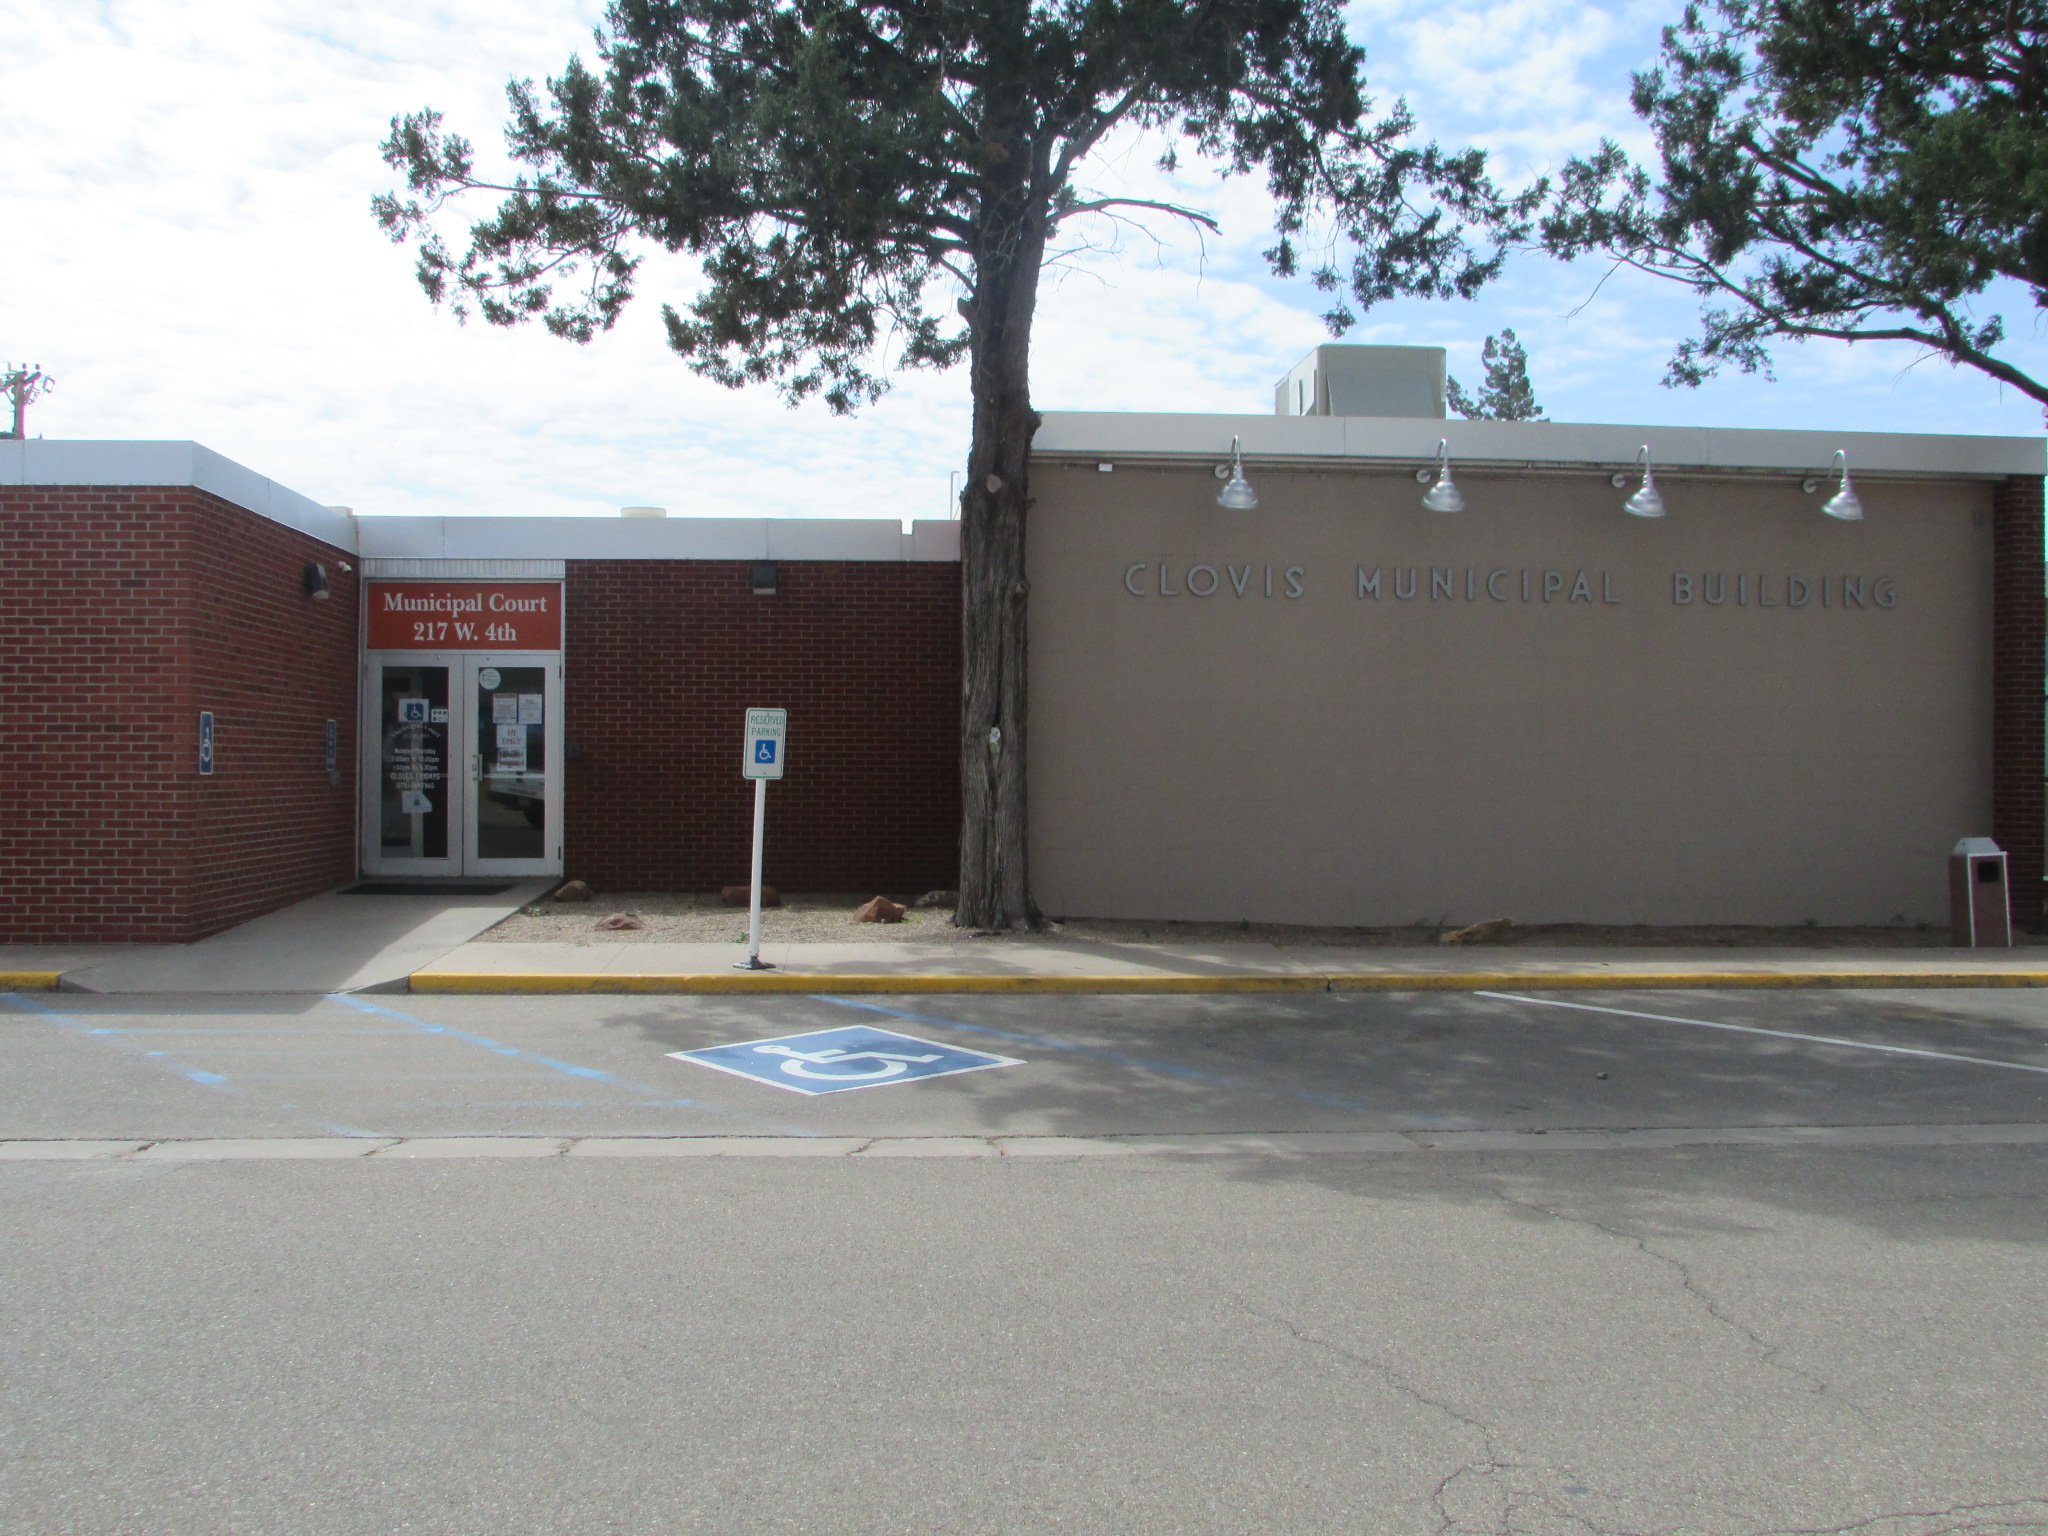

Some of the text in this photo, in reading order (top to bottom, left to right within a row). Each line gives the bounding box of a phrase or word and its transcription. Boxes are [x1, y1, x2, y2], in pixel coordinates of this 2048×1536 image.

[1124, 562, 1900, 609] CLOVIS MUNICIPAL BUILDING
[383, 592, 548, 618] Municipal Court
[413, 622, 518, 641] 217 W. 4th
[751, 715, 784, 725] RESERVED
[507, 728, 516, 737] IN
[752, 727, 781, 737] PARKING
[502, 737, 521, 745] ONLY
